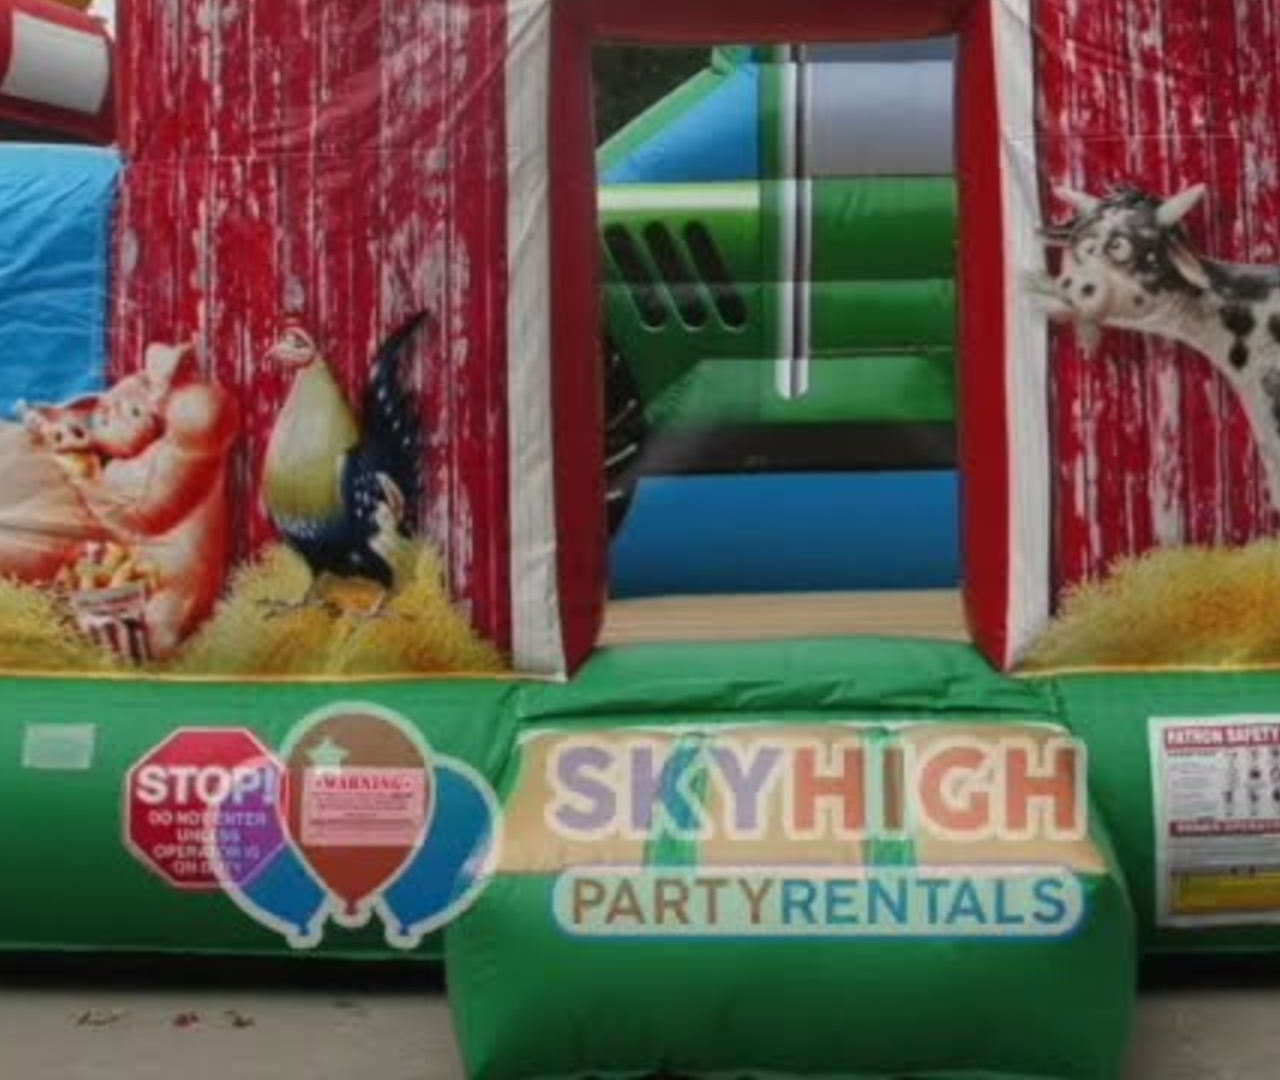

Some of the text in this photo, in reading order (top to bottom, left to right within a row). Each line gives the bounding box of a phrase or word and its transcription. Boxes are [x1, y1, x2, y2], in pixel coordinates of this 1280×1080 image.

[1227, 726, 1279, 744] SAFETY
[135, 765, 275, 805] STOP!
[147, 810, 173, 827] DO
